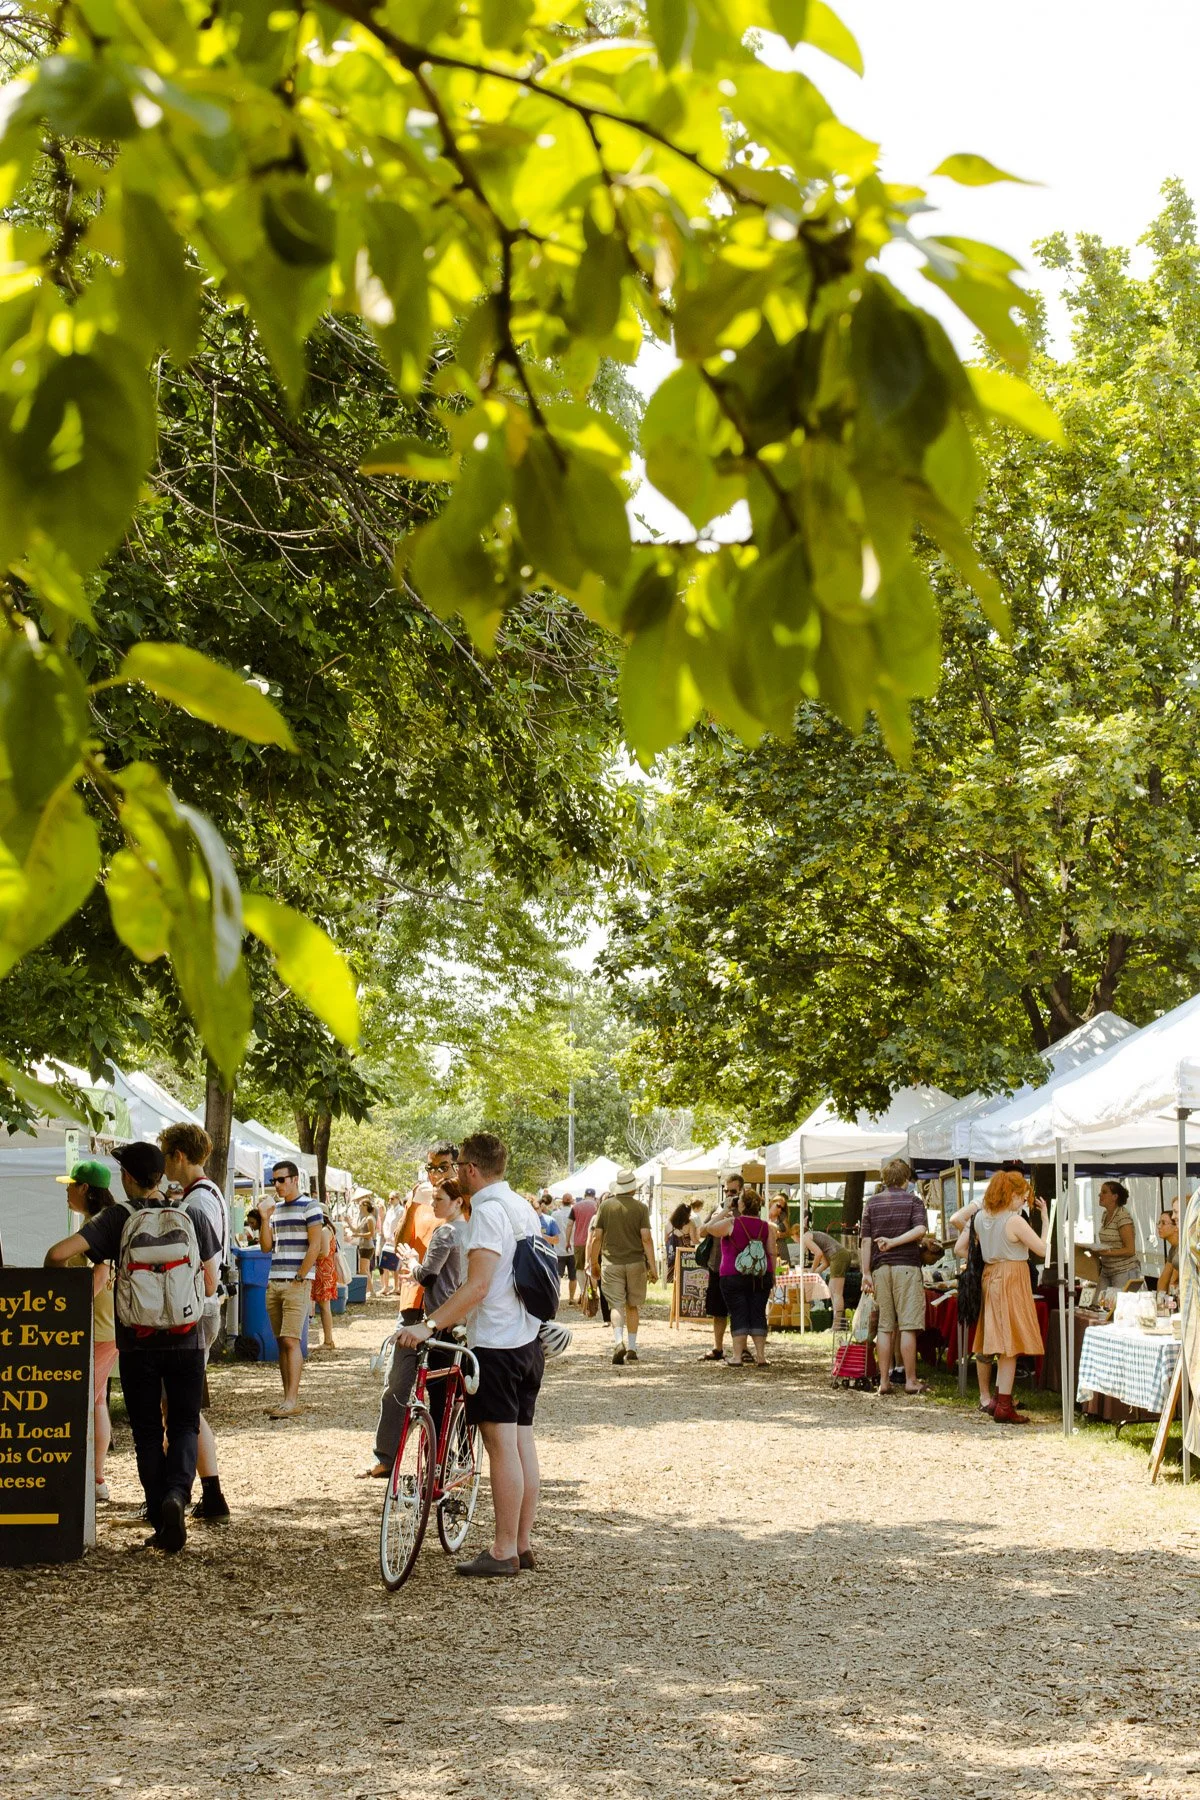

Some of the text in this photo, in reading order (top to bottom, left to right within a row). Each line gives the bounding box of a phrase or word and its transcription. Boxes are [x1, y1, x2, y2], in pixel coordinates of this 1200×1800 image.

[18, 1324, 85, 1346] Ever
[1, 1365, 83, 1382] d Cheese
[1, 1390, 49, 1411] ND
[16, 1421, 71, 1439] Local
[26, 1447, 72, 1464] Cow
[0, 1476, 46, 1489] eese
